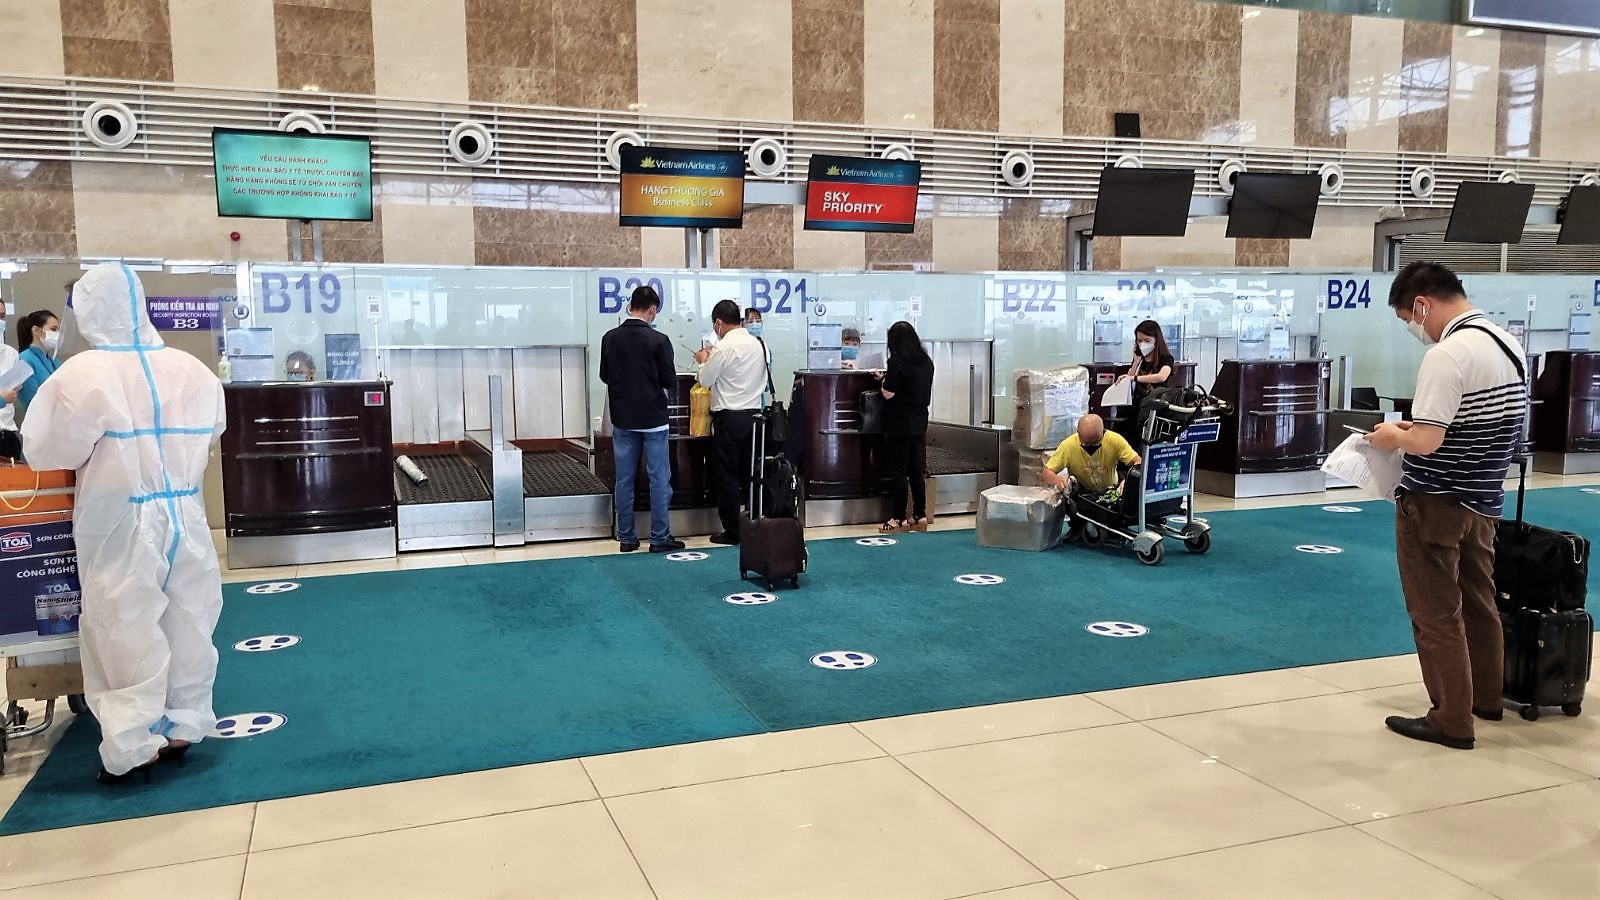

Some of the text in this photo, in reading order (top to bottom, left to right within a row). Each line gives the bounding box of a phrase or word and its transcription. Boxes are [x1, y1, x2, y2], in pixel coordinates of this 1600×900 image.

[655, 159, 716, 171] Vietnam Airlines
[840, 167, 869, 177] Vietnam
[823, 191, 850, 202] SKY
[653, 197, 713, 208] Business Class
[822, 202, 883, 214] PRIORITY
[261, 272, 341, 314] B19
[750, 278, 807, 313] B21
[1003, 279, 1056, 312] B22
[1327, 279, 1372, 309] B24
[185, 301, 196, 311] TRA
[172, 318, 200, 329] B3
[3, 537, 29, 548] TOA
[43, 557, 65, 566] SƠN
[16, 564, 76, 578] CÔNG NGHỆ
[45, 583, 71, 593] TOA
